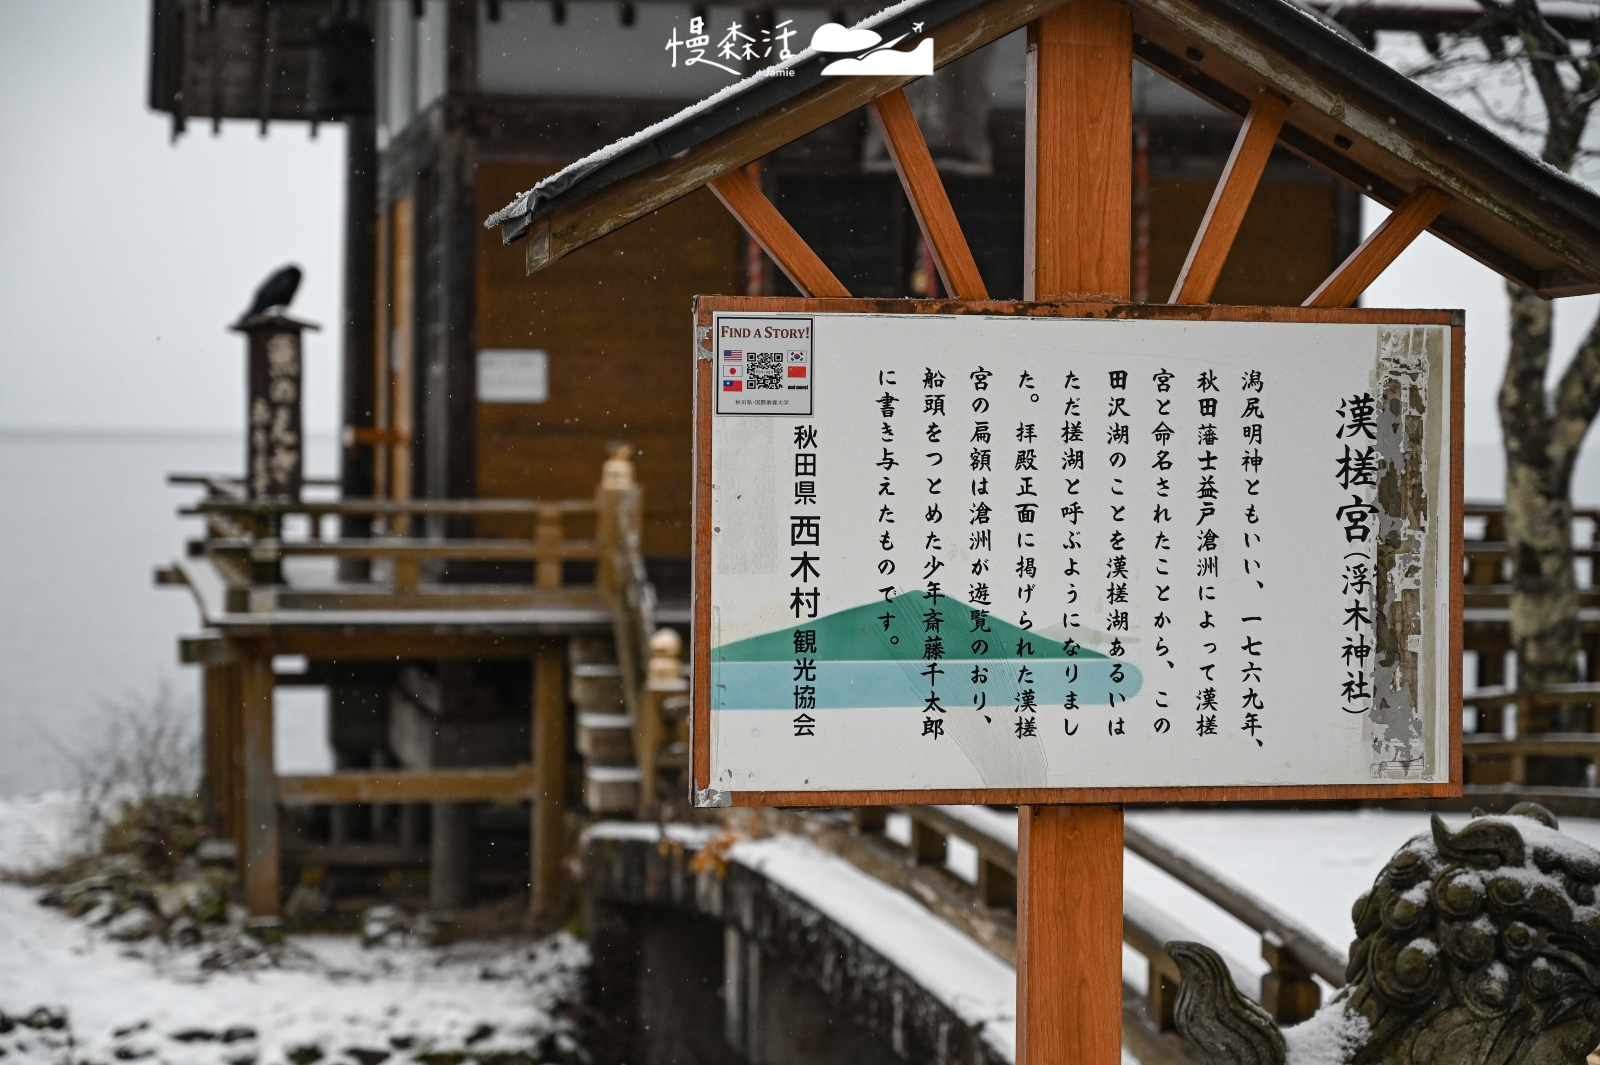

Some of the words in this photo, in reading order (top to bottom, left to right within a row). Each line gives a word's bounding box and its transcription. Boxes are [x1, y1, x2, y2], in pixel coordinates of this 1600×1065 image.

[753, 328, 762, 338] A
[875, 369, 900, 646] に書き与えたものです。
